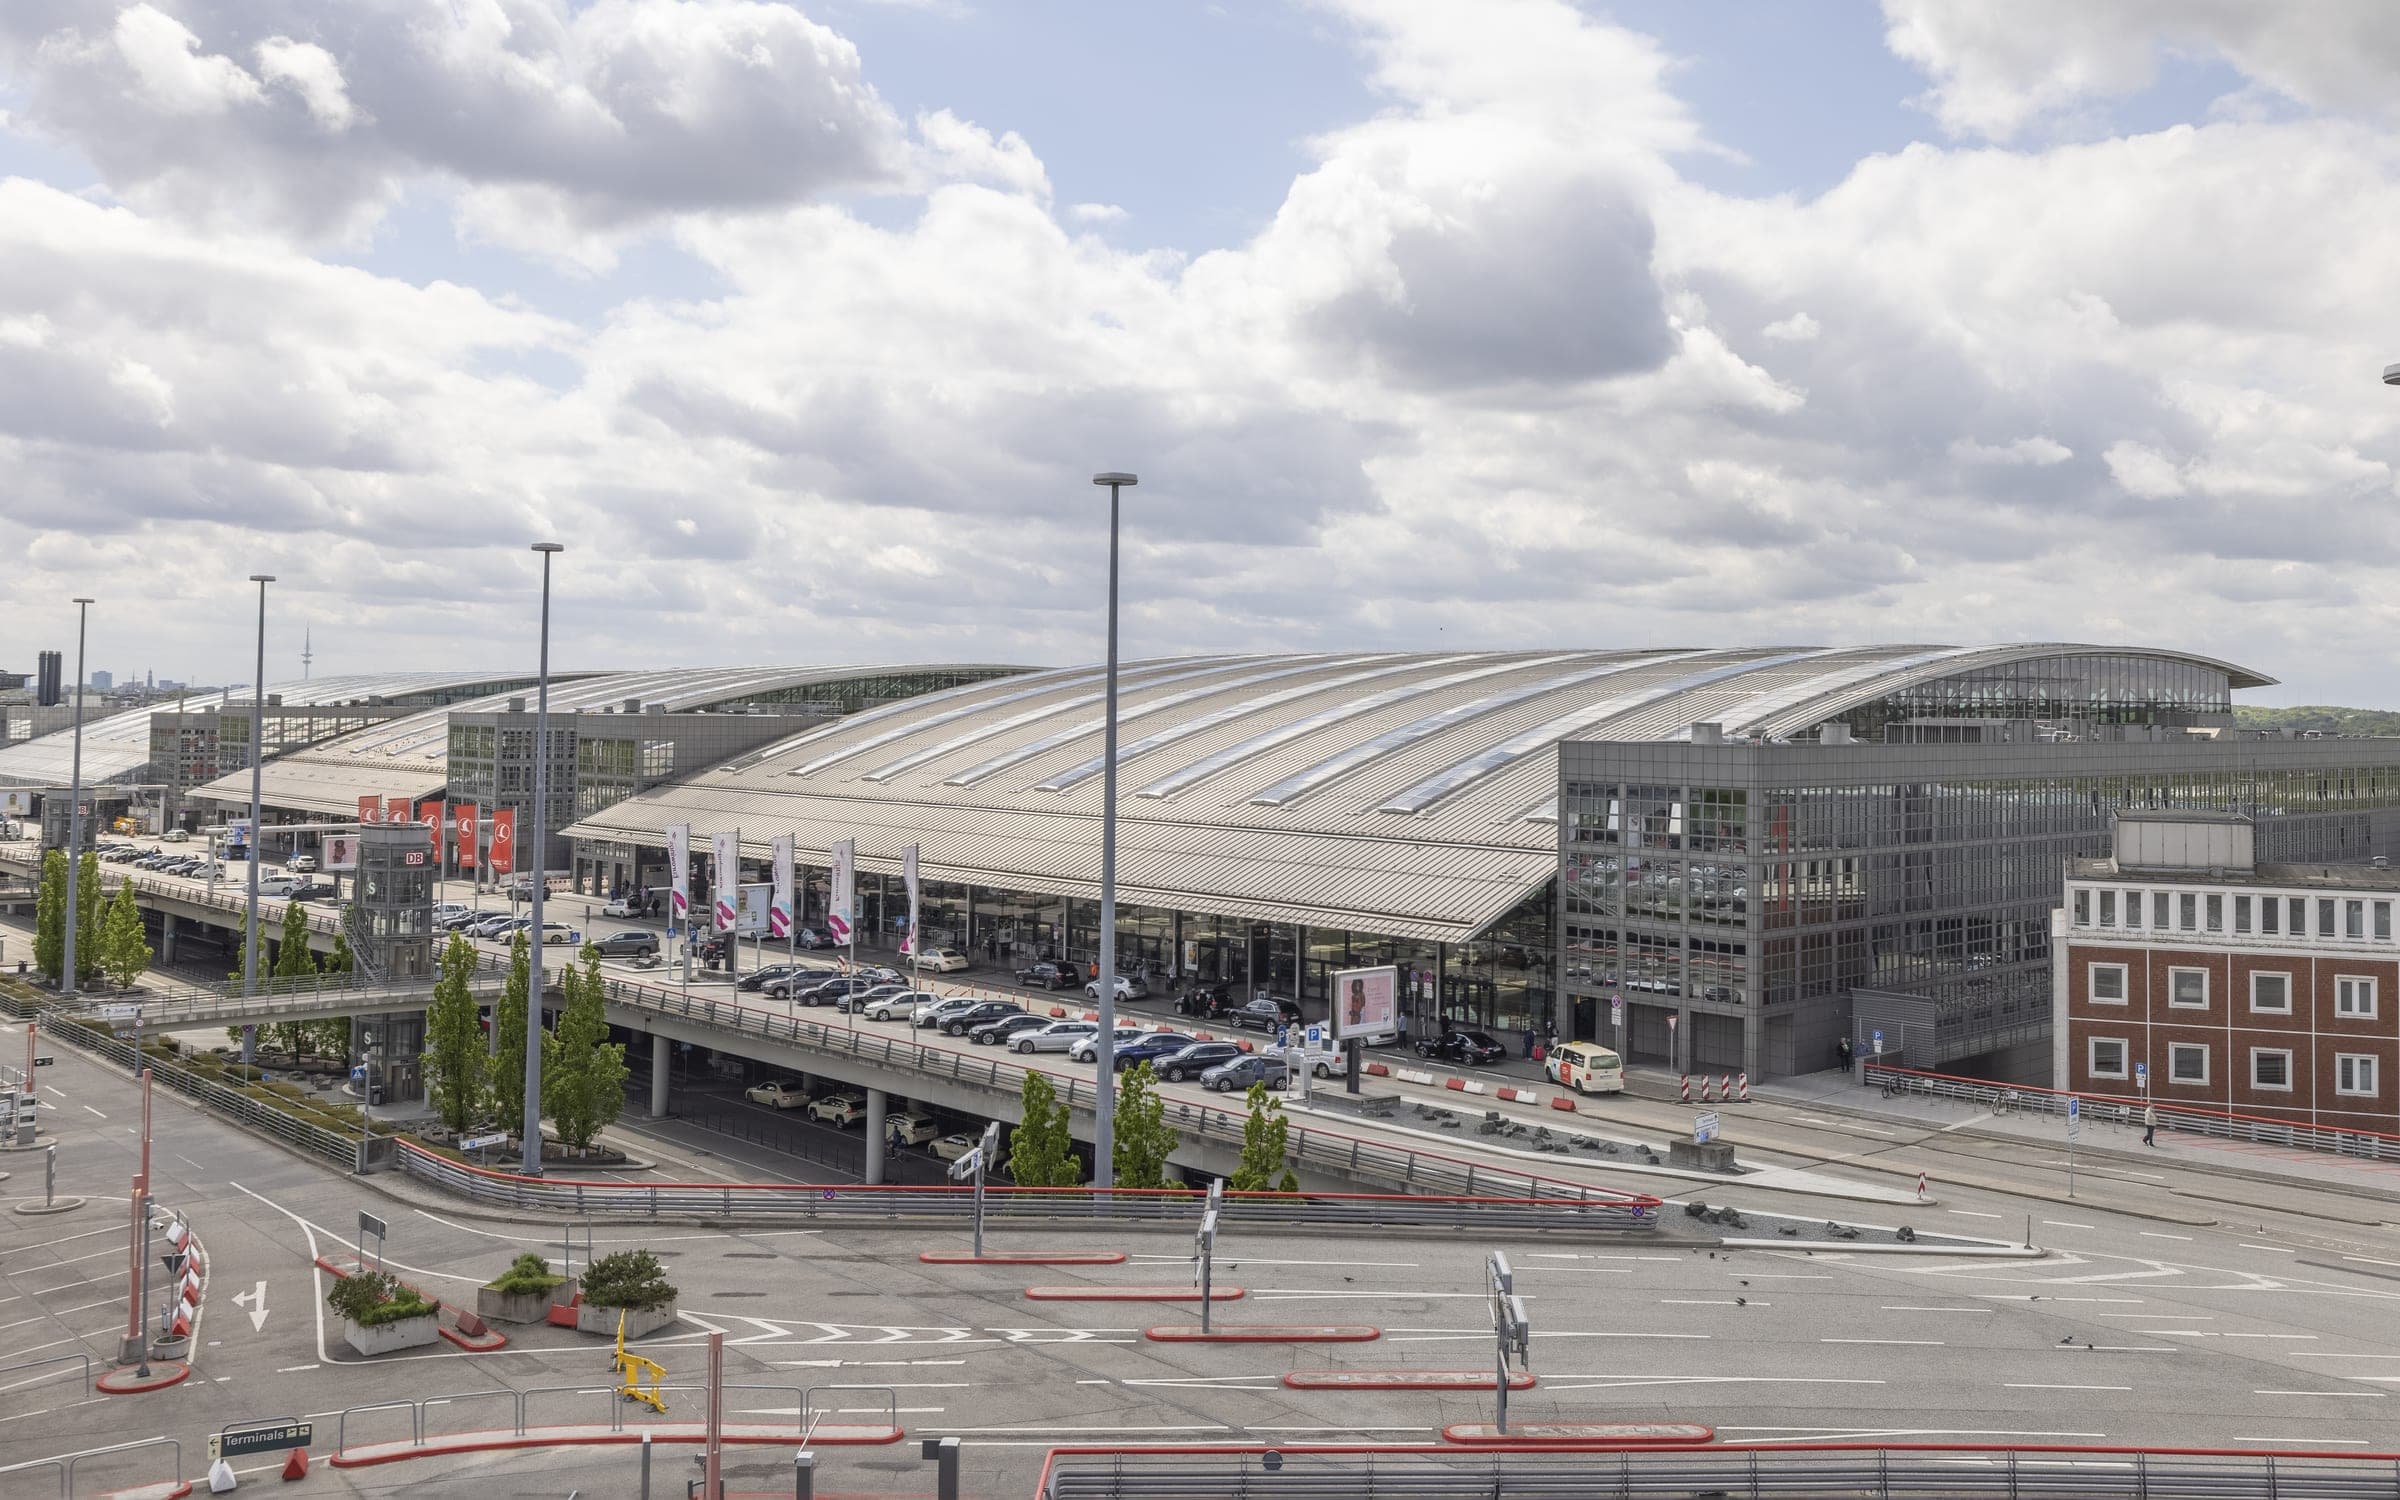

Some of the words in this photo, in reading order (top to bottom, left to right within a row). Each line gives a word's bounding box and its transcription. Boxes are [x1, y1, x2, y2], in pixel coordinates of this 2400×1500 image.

[407, 853, 422, 864] DB
[368, 882, 376, 894] S
[364, 1031, 371, 1045] S
[1278, 1030, 1285, 1042] P
[1311, 1030, 1318, 1040] P
[2137, 1065, 2144, 1073] P
[224, 1430, 284, 1446] Terminals
